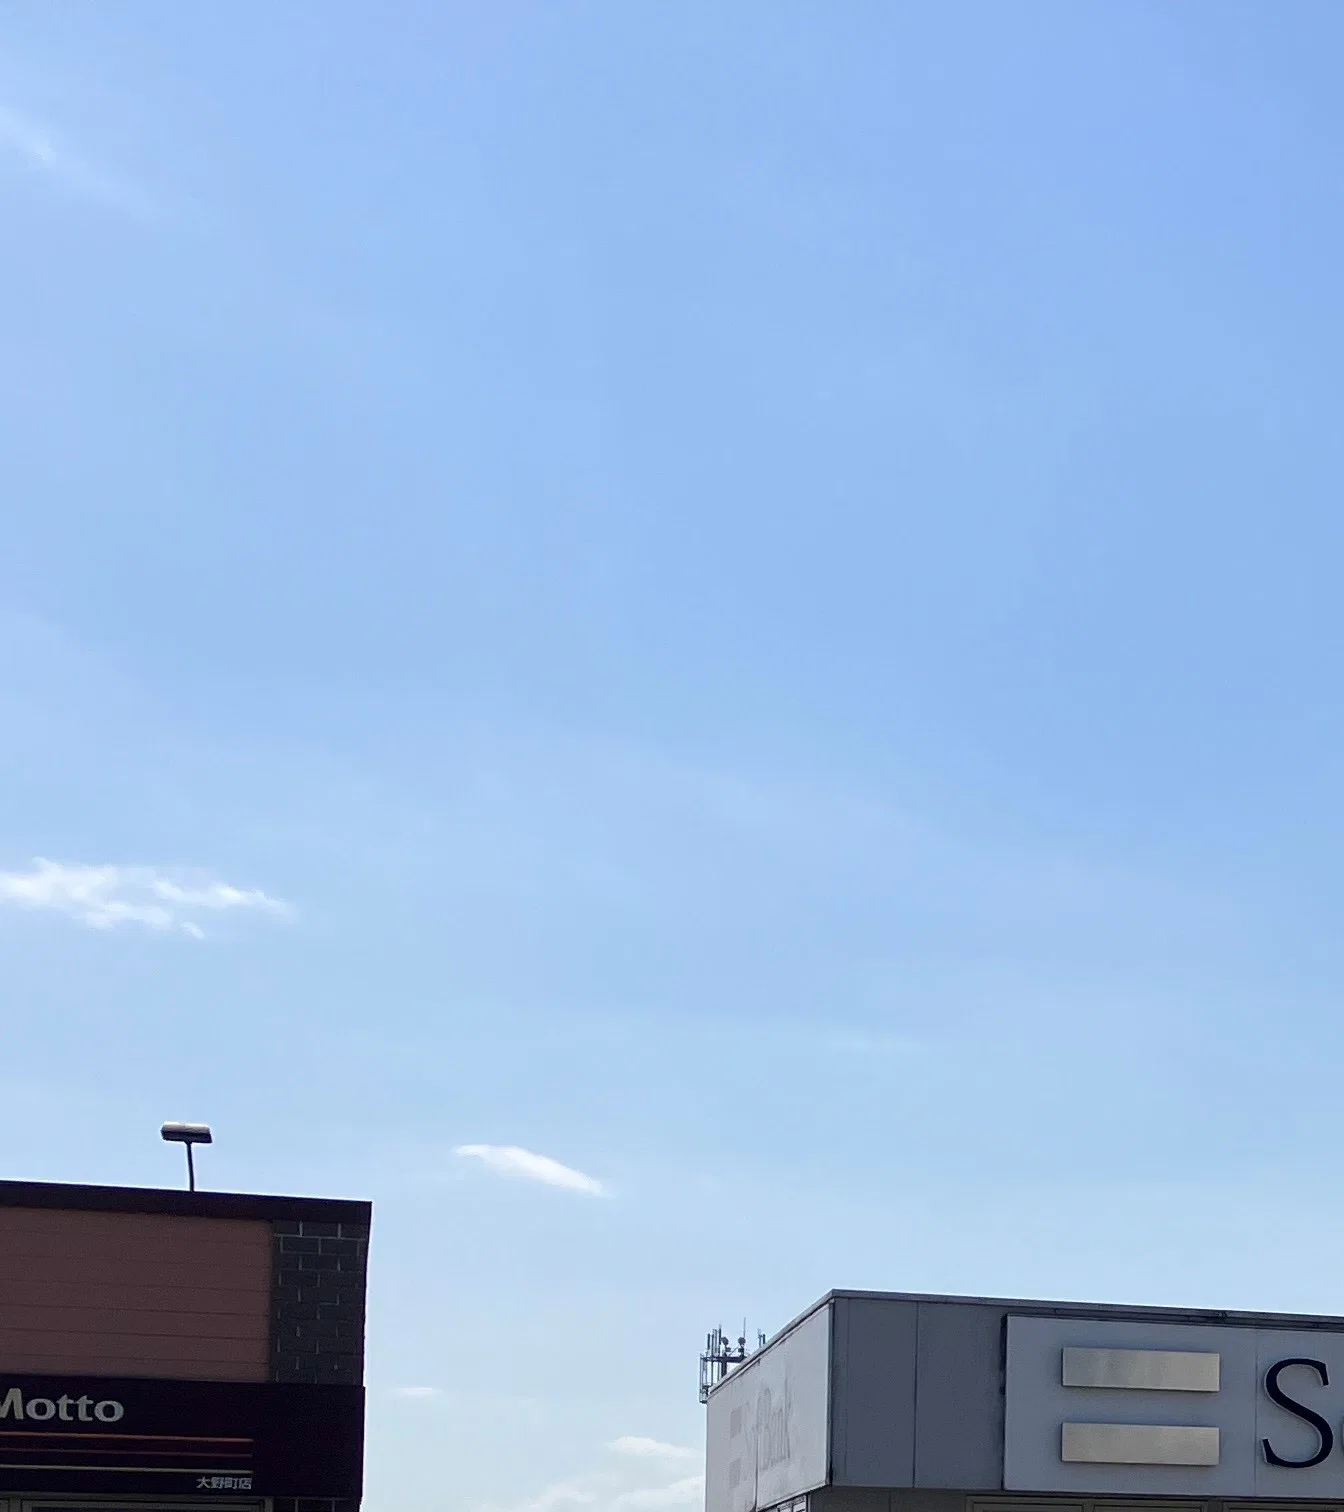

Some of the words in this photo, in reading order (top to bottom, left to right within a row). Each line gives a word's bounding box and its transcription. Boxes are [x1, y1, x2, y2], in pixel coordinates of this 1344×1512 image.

[0, 1387, 124, 1423] Motto
[196, 1475, 253, 1491] 大野町店
